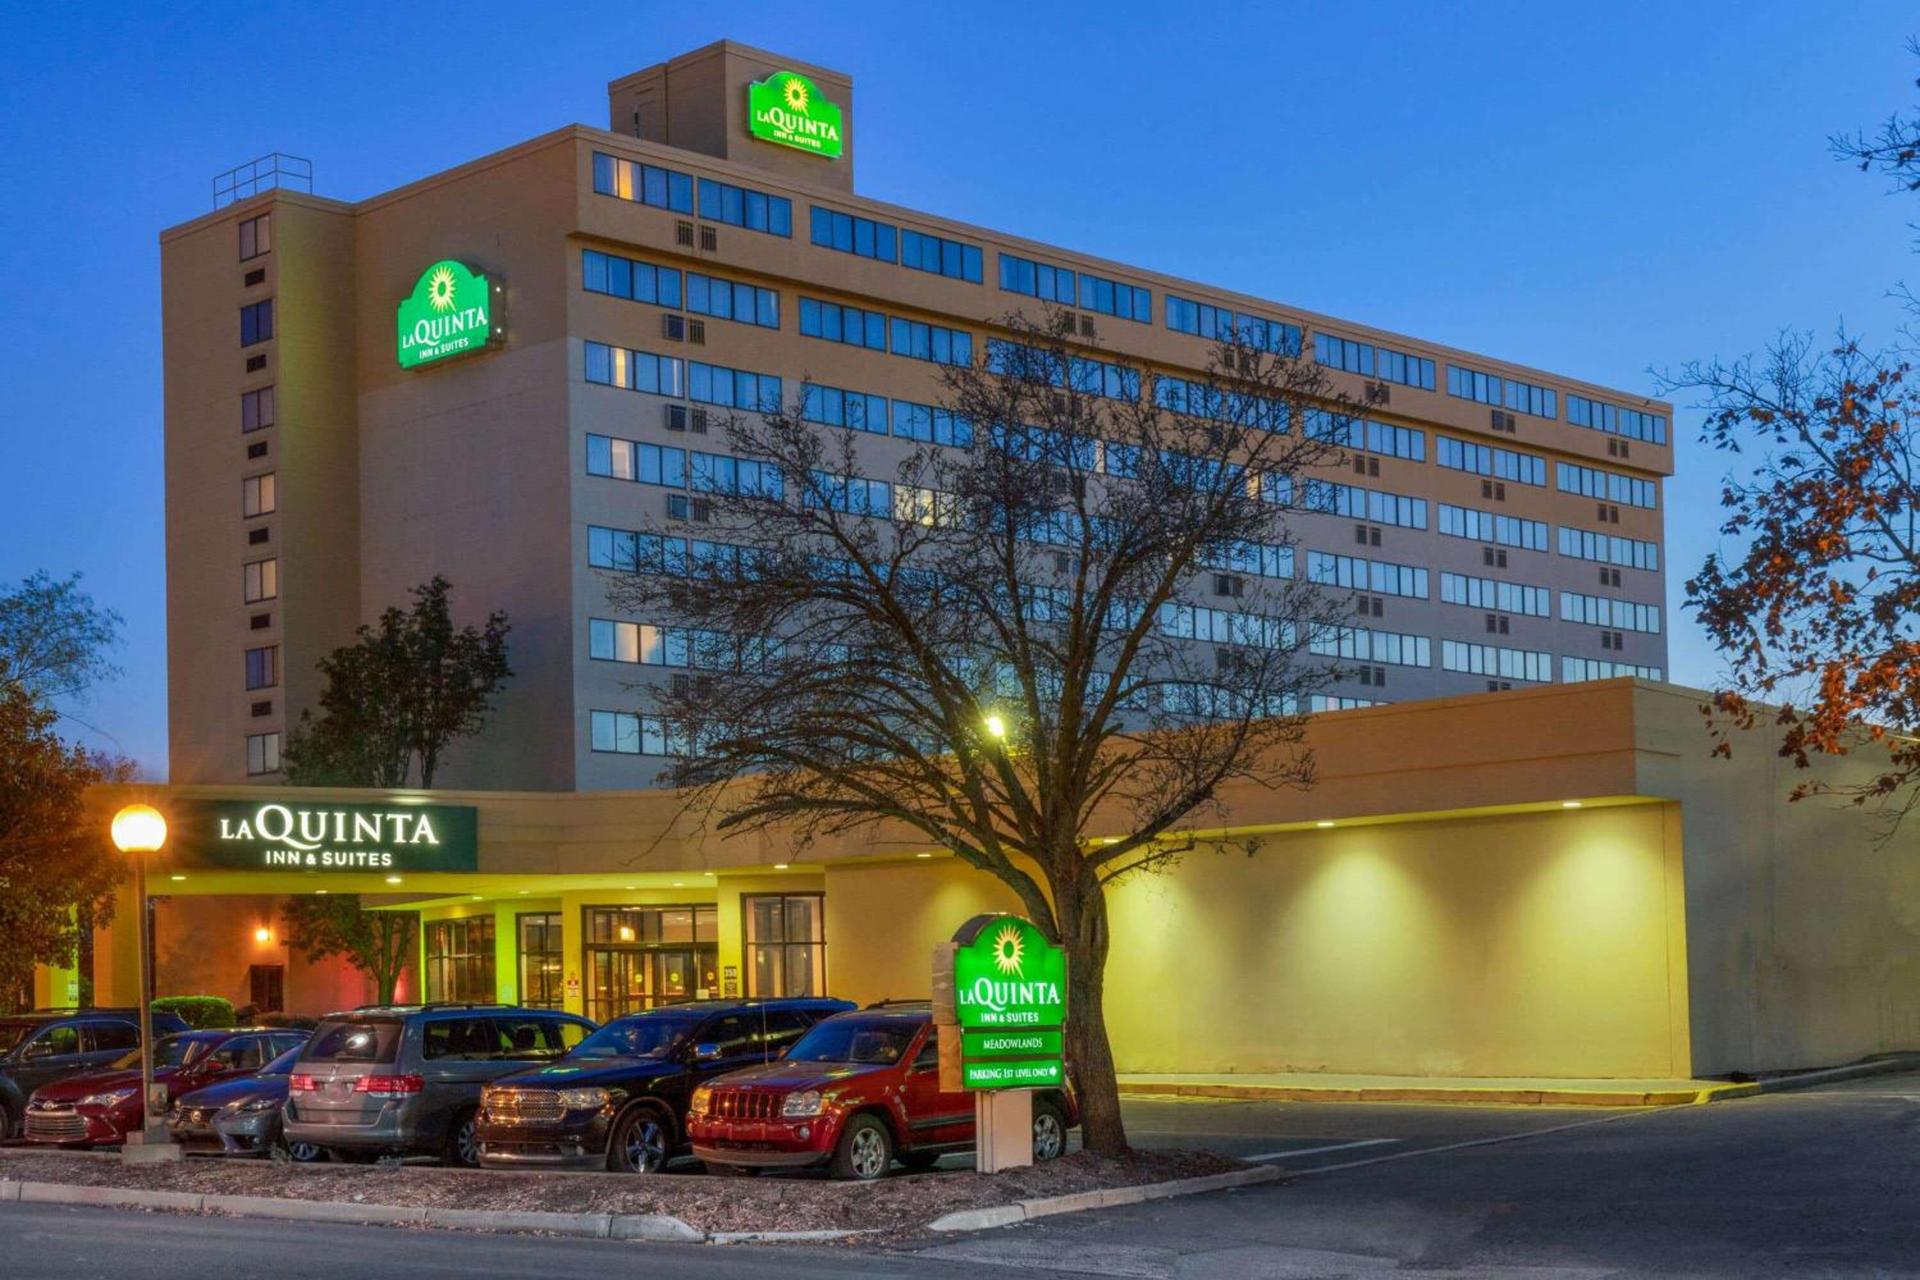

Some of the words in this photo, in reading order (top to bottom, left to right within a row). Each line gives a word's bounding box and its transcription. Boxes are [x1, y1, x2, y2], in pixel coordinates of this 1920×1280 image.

[441, 337, 469, 353] SUITES
[266, 851, 300, 864] INN
[306, 853, 316, 865] &
[322, 852, 393, 866] SUITES
[980, 1012, 998, 1023] INN
[999, 1014, 1006, 1023] &
[1007, 1012, 1040, 1023] SUITES
[982, 1037, 1043, 1050] MEADOWLANDS
[969, 1068, 1002, 1080] PARKING
